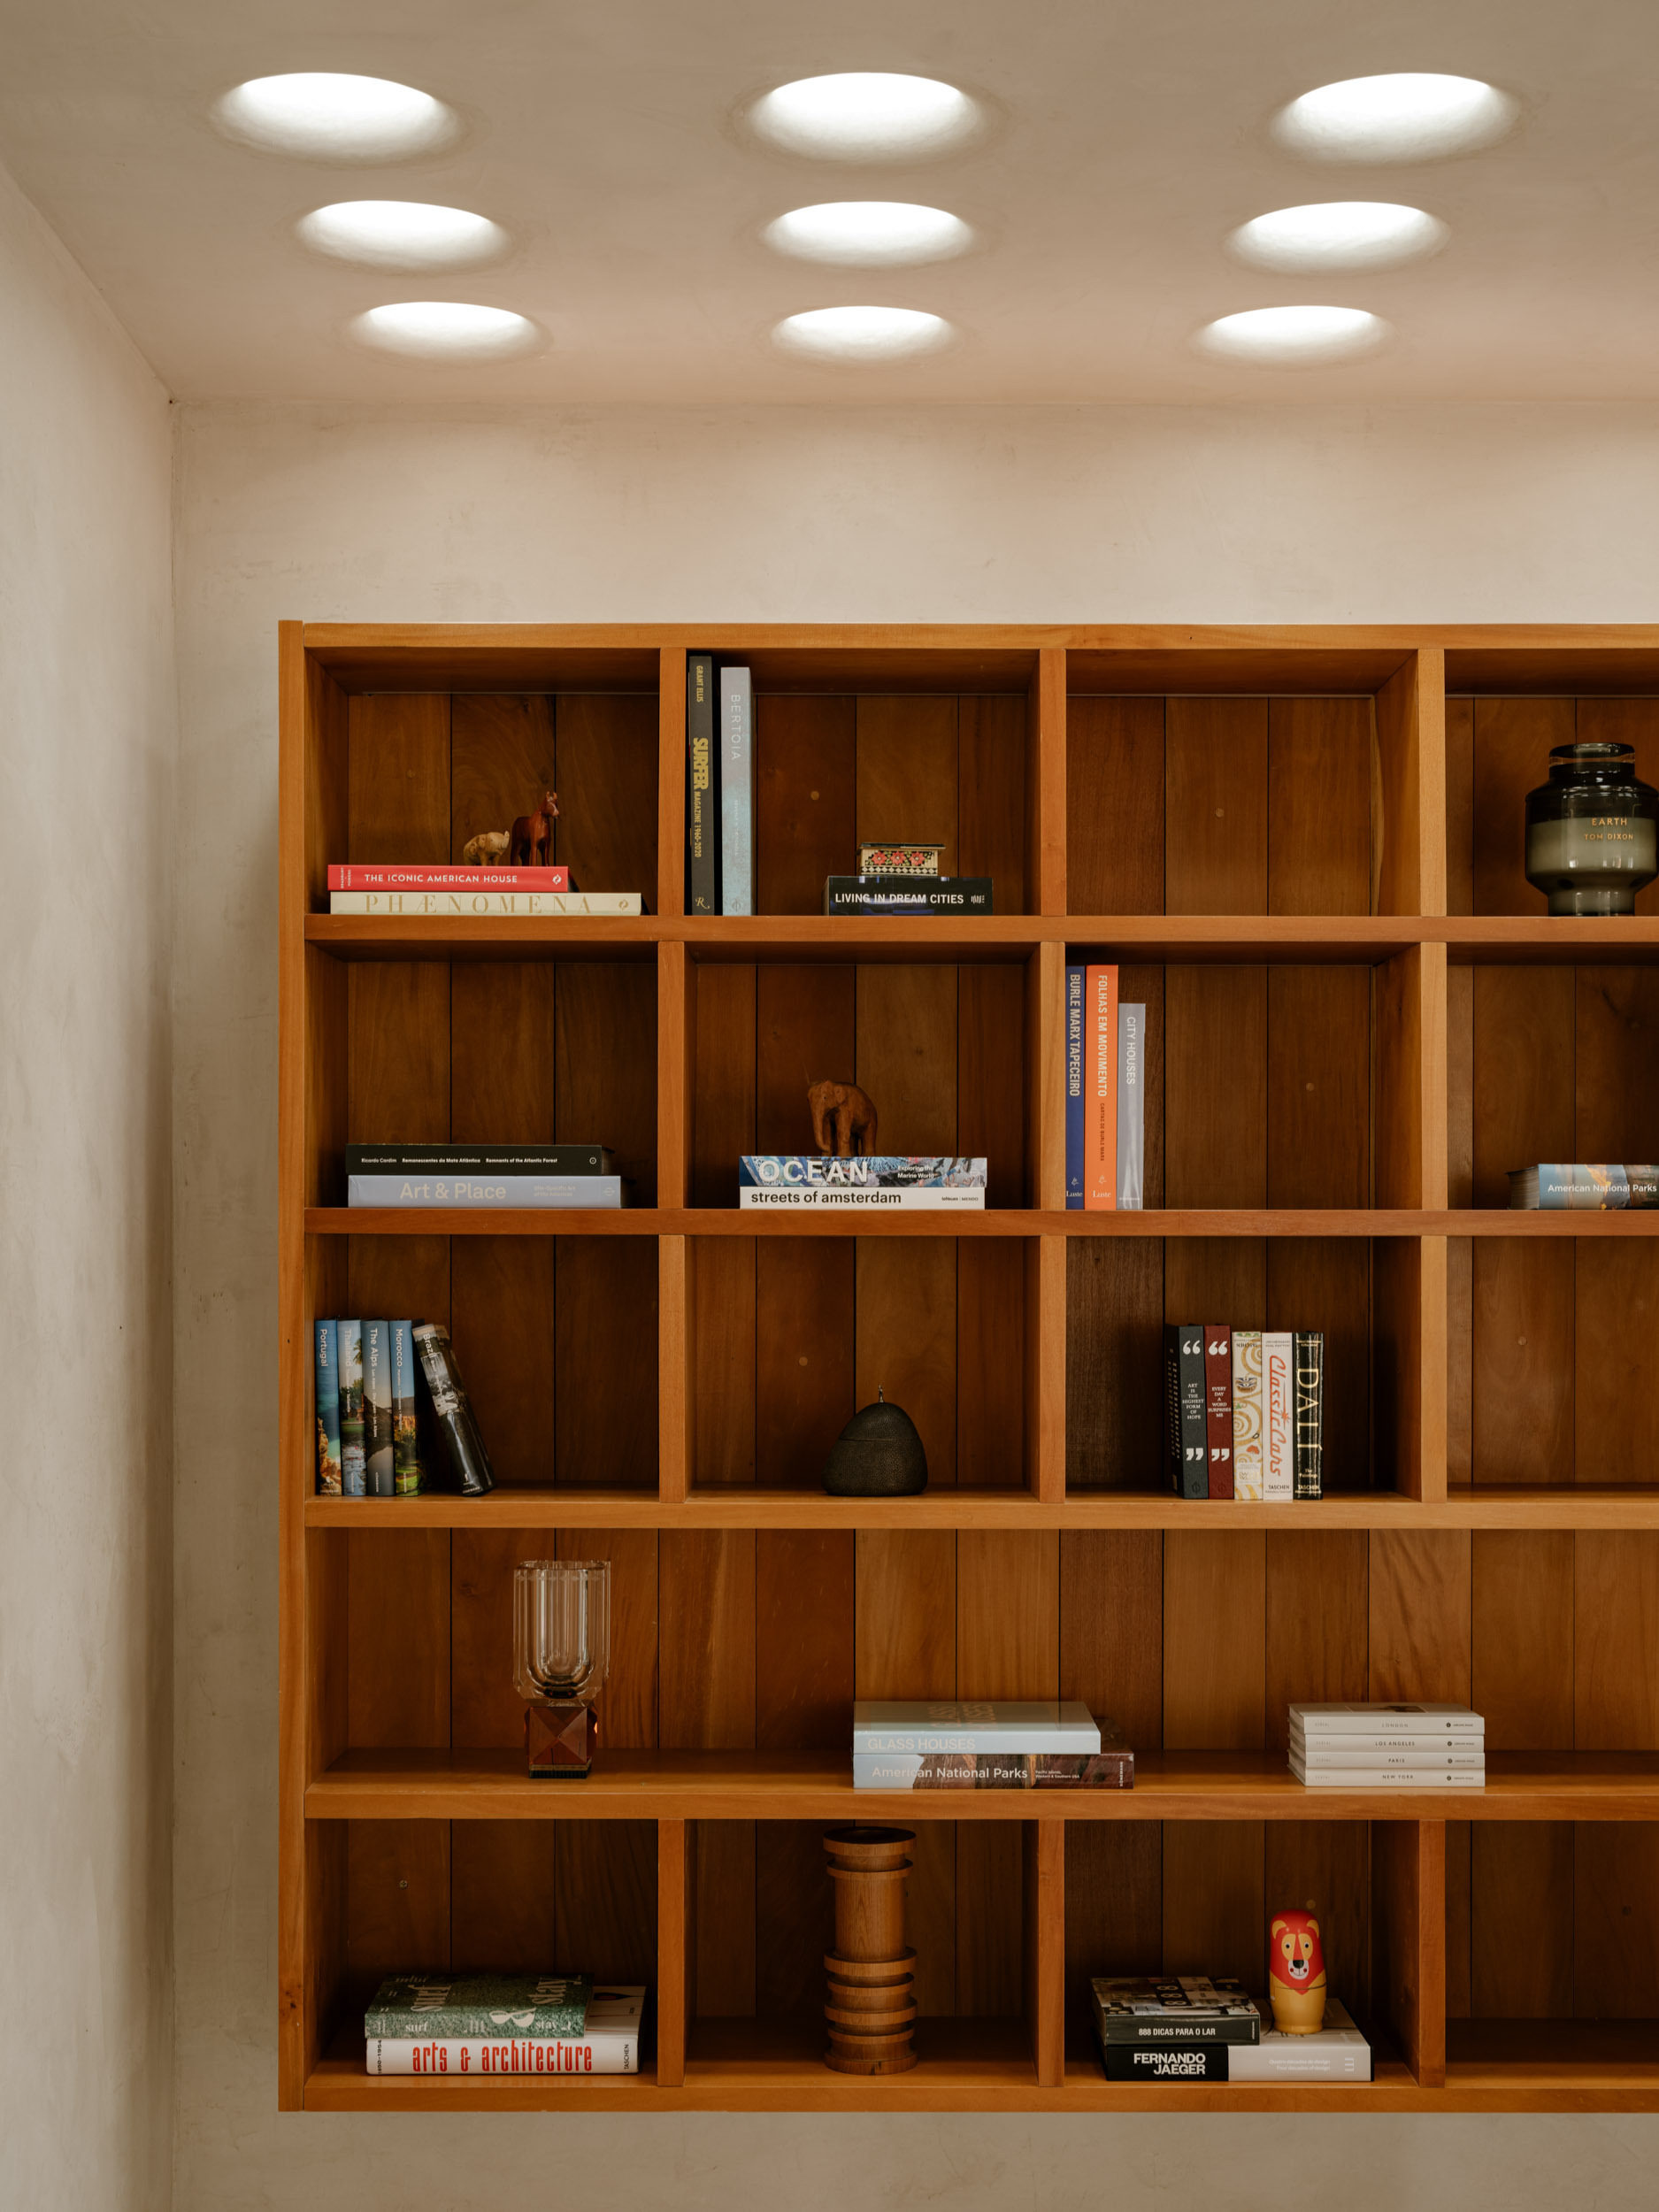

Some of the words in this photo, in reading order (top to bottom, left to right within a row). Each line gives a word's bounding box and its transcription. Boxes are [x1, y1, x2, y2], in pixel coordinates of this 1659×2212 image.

[731, 695, 741, 760] BERTOIA
[694, 737, 709, 790] SURFER
[365, 874, 384, 883] THE
[388, 874, 423, 883] ICONIC
[427, 874, 479, 883] AMERICAN
[483, 874, 518, 883] HOUSE
[835, 893, 870, 903] LIVING
[874, 894, 885, 903] IN
[889, 894, 926, 903] DREAM
[930, 894, 964, 904] CITIES
[1070, 974, 1080, 1006] BURLE
[1098, 975, 1108, 1013] FOLHAS
[1070, 1009, 1080, 1040] MARX
[1098, 1017, 1107, 1031] EM
[1126, 1017, 1136, 1039] CITY
[1070, 1041, 1080, 1096] TAPECEIRO
[1098, 1034, 1107, 1096] MOVIMENTO
[1126, 1042, 1136, 1085] HOUSES
[759, 1161, 867, 1183] OCEAN
[400, 1183, 430, 1200] Art
[435, 1182, 449, 1200] &
[455, 1182, 506, 1199] Place
[751, 1192, 800, 1203] streets
[803, 1191, 818, 1203] of
[821, 1191, 901, 1203] amsterdam
[1593, 1184, 1630, 1193] National
[319, 1329, 328, 1366] Portugal
[423, 1333, 436, 1358] Brazil
[1297, 1369, 1323, 1450] DALÍ
[868, 1738, 914, 1750] GLASS
[918, 1738, 976, 1750] HOUSES
[872, 1767, 933, 1778] American
[937, 1768, 989, 1778] National
[994, 1768, 1027, 1778] Parks
[1156, 1985, 1187, 2006] 888
[405, 2022, 428, 2032] surf
[535, 2020, 557, 2032] stay
[412, 2042, 447, 2072] arts
[461, 2047, 471, 2072] &
[482, 2040, 592, 2071] architecture
[1134, 2053, 1206, 2064] FERNANDO
[1154, 2064, 1206, 2075] JAEGER
